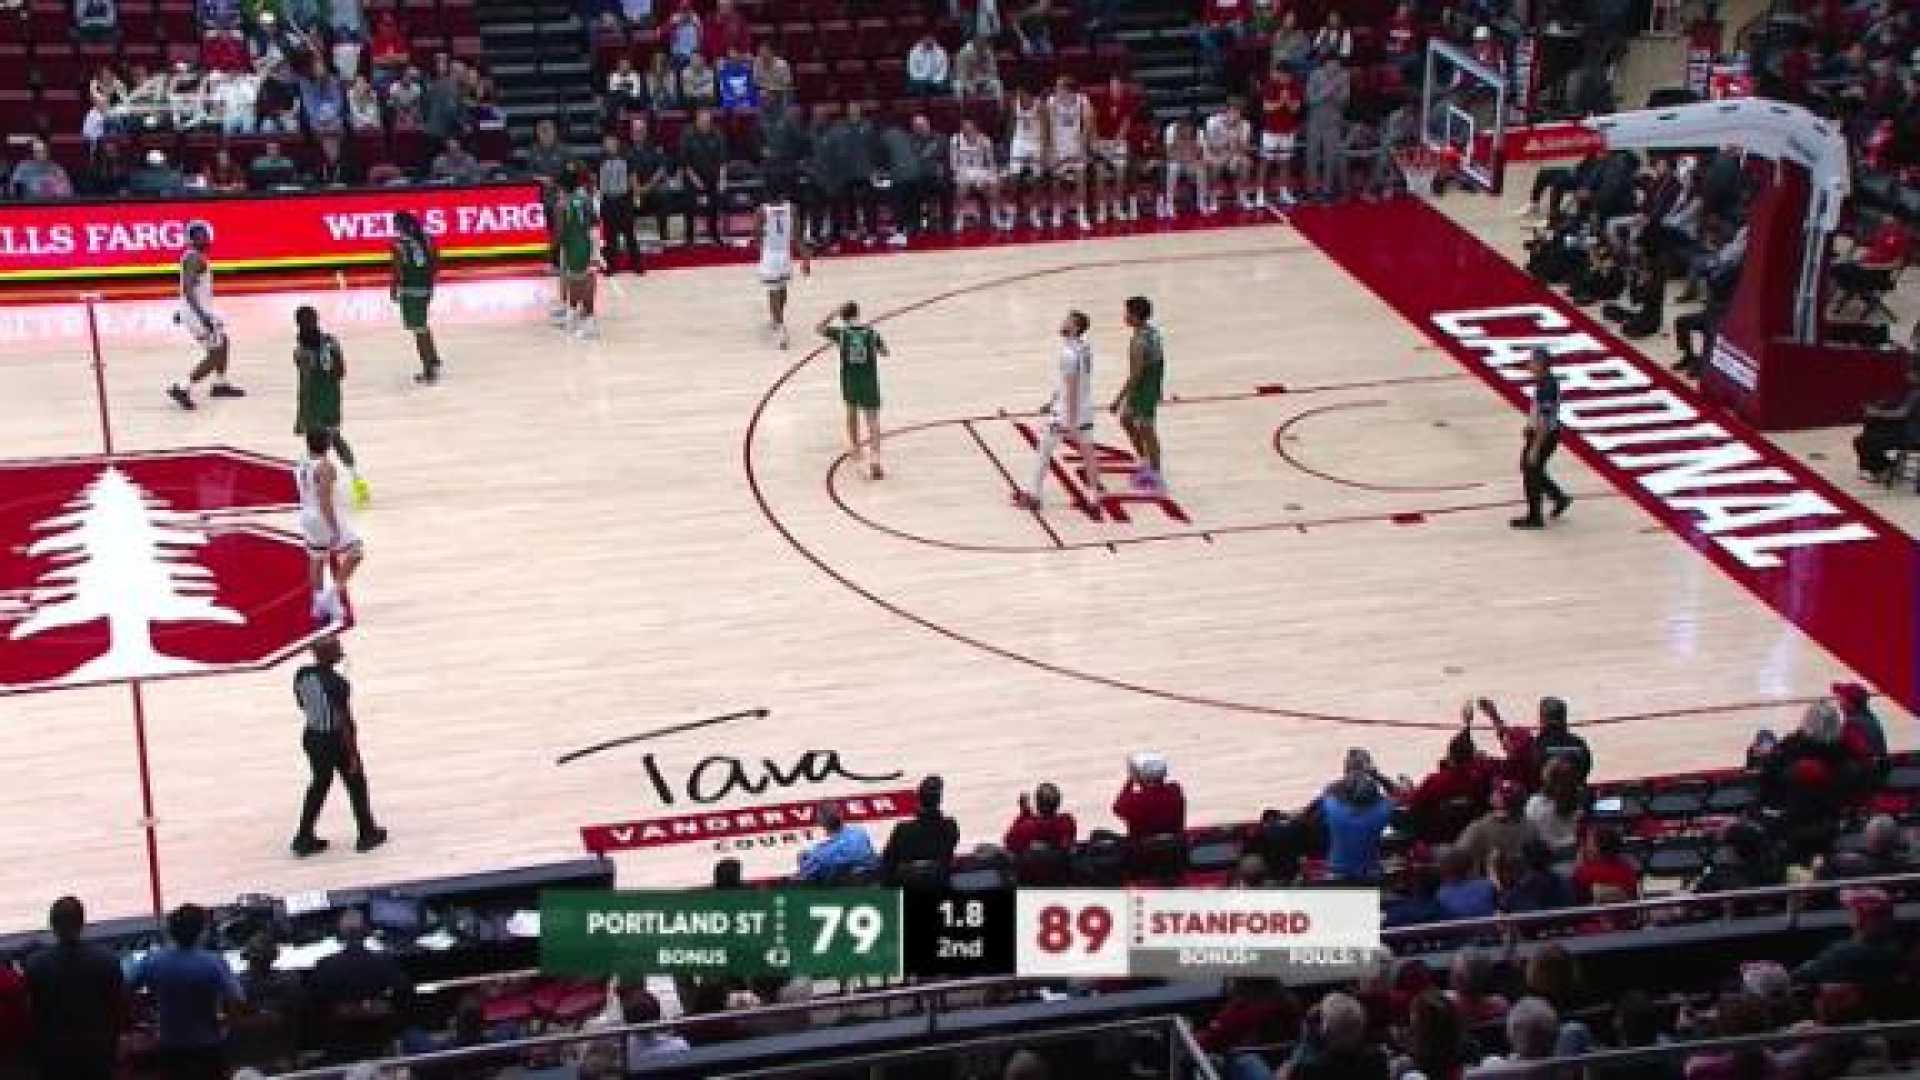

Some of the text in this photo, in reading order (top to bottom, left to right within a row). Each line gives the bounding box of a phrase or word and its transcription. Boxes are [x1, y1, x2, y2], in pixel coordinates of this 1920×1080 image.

[323, 212, 447, 240] WELS
[1430, 303, 1880, 569] CARDINAL
[608, 796, 897, 844] VANDERVER
